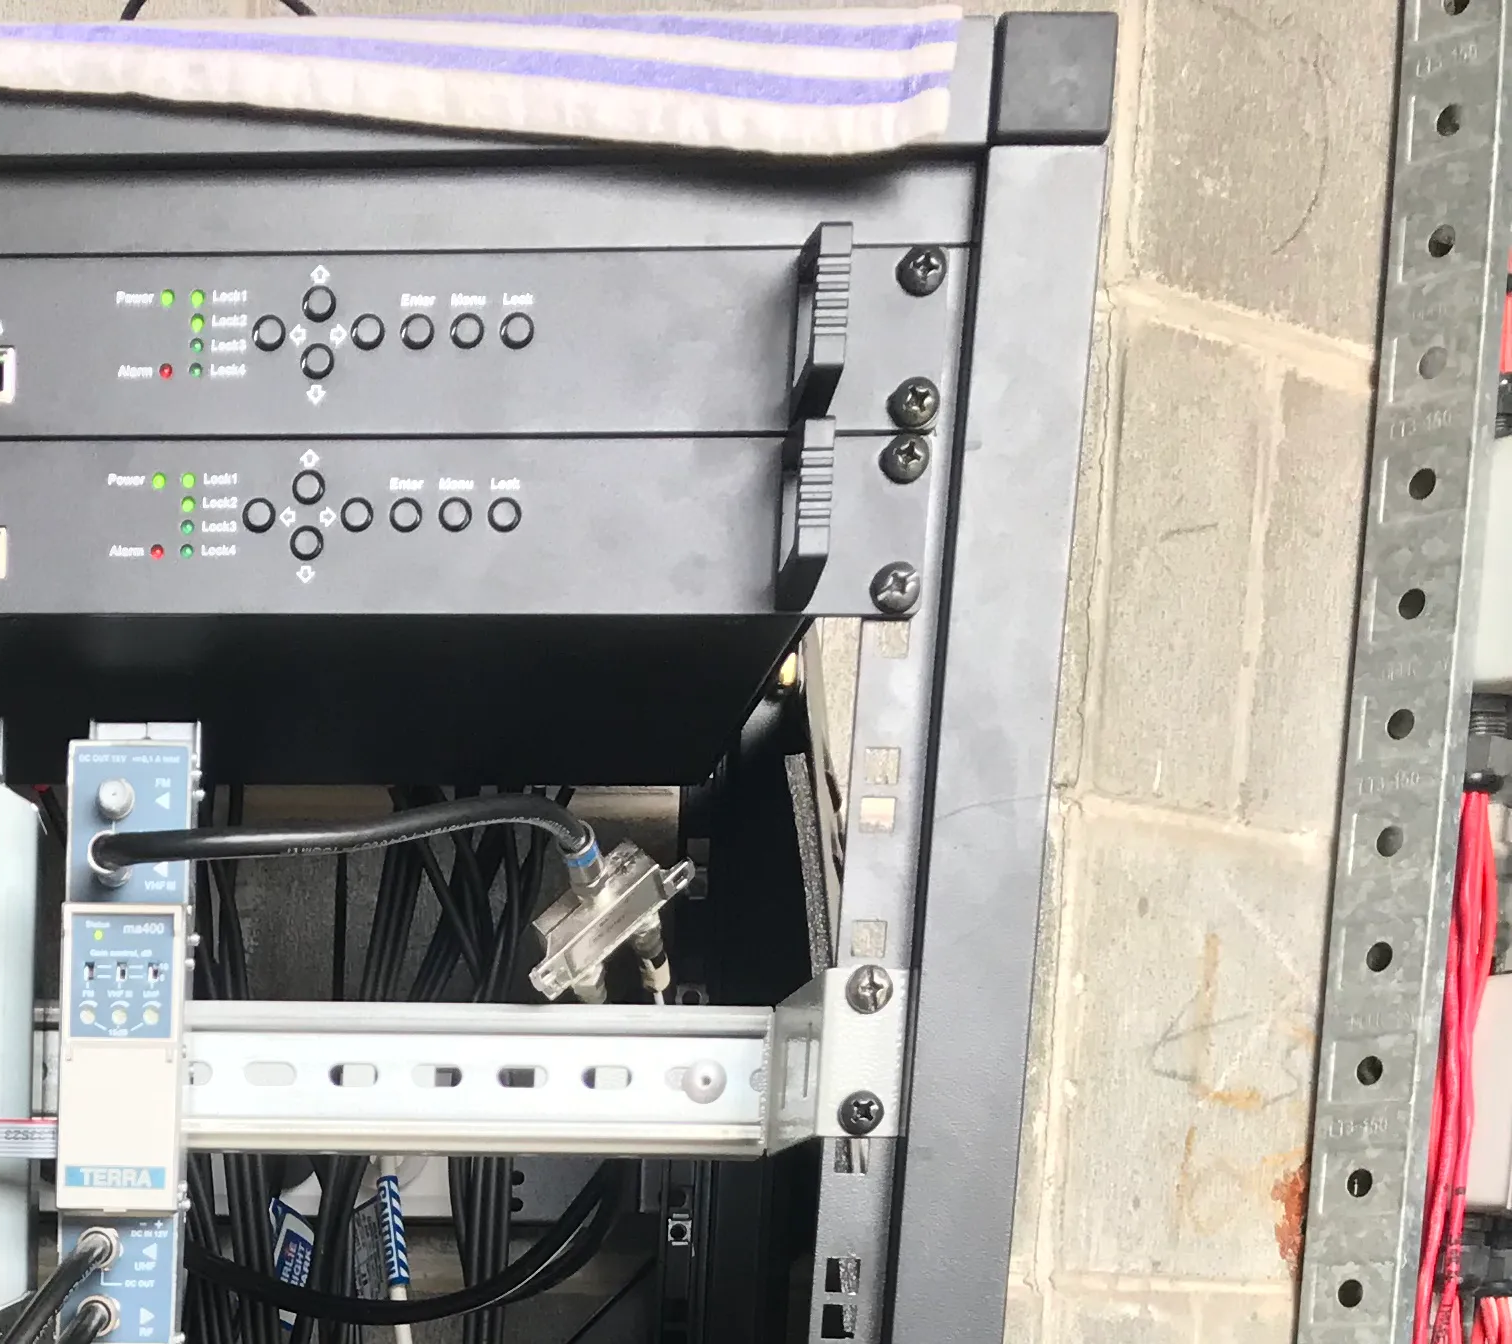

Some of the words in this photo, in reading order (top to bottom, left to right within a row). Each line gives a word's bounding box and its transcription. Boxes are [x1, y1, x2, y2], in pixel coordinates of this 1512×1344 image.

[115, 291, 154, 304] Power
[212, 289, 247, 303] Lock1
[400, 292, 436, 307] Enter
[451, 293, 486, 307] Menu
[502, 292, 534, 306] Lock
[211, 314, 247, 327] Lock2
[117, 364, 153, 377] Alarm
[107, 473, 146, 487] Power
[203, 472, 238, 485] Lock1
[389, 477, 424, 491] Enter
[439, 477, 475, 492] Menu
[490, 477, 521, 491] Lock
[202, 496, 237, 509] Lock2
[201, 520, 237, 533] Lock3
[109, 545, 144, 558] Alarm
[201, 544, 236, 558] Lock4
[123, 922, 165, 934] ma400
[80, 1168, 152, 1189] TERRA
